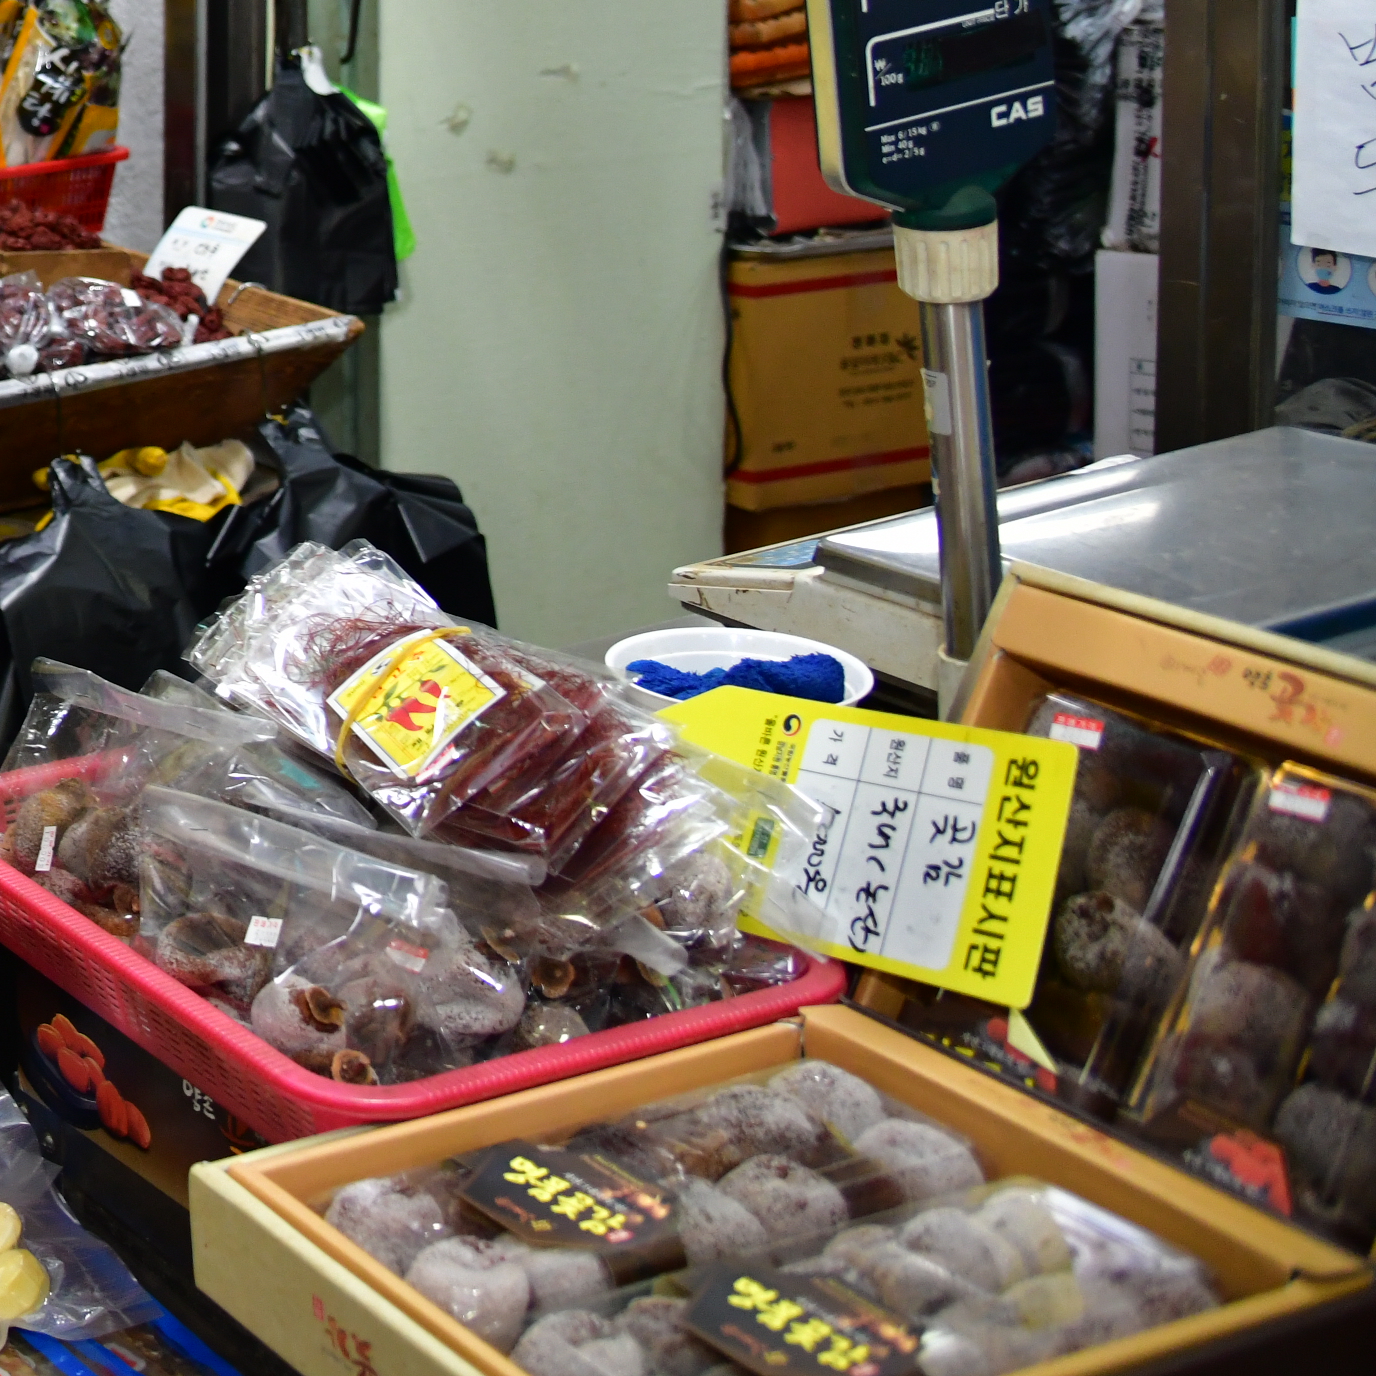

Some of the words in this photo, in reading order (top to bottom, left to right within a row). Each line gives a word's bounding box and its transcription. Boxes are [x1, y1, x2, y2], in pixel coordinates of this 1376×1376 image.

[990, 95, 1045, 129] CAS
[821, 729, 845, 767] 가격
[882, 737, 908, 780] 원산지
[964, 756, 1040, 980] 원산지표시판
